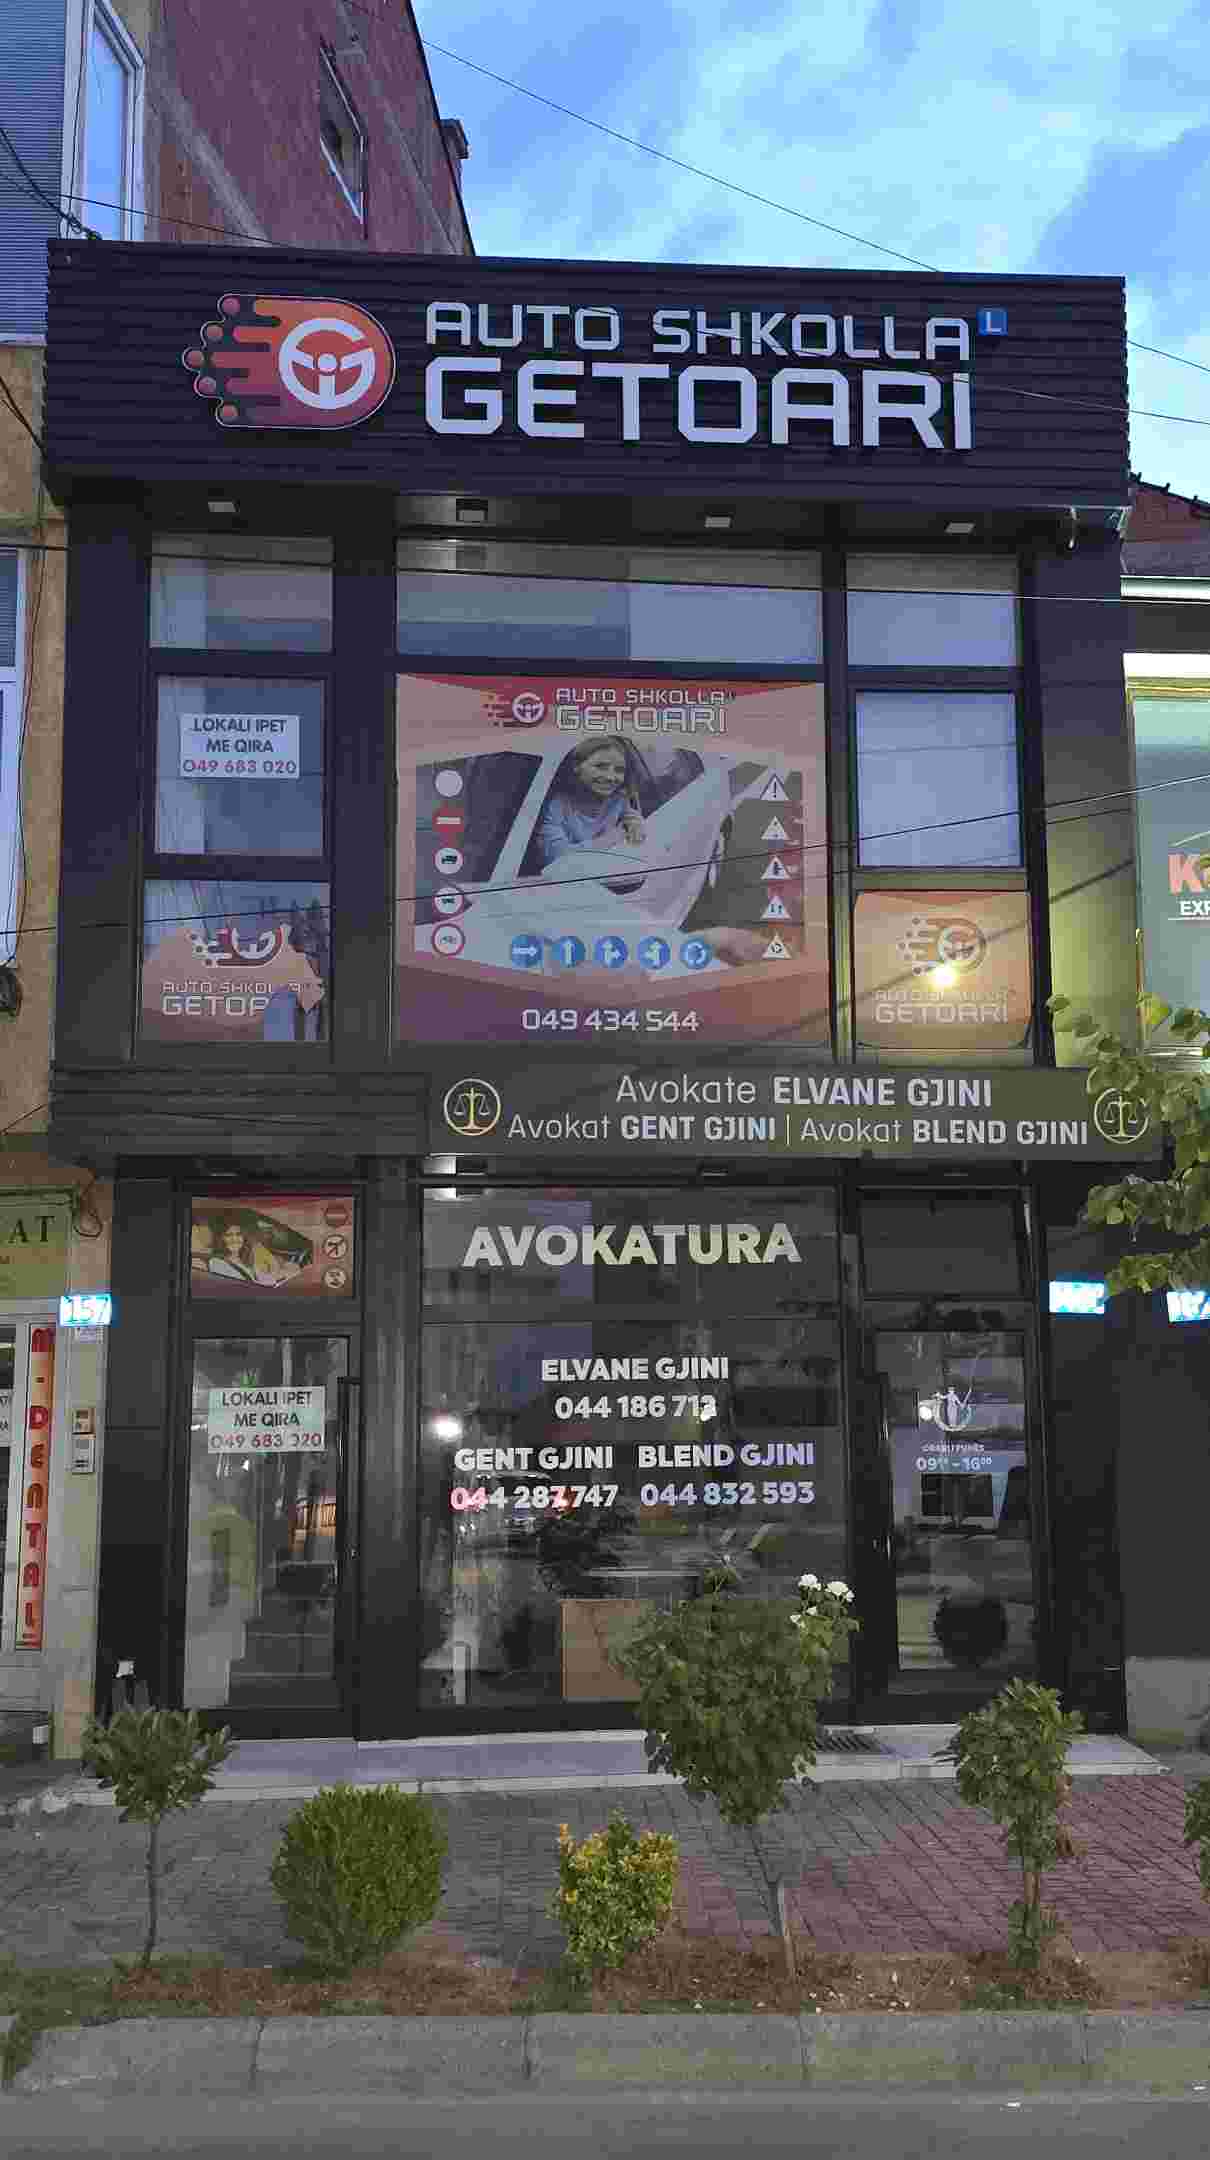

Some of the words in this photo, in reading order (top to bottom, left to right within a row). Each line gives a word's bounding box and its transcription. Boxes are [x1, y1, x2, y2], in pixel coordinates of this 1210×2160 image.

[425, 301, 620, 350] AUTO
[652, 310, 970, 361] SHKOLLA
[986, 311, 1001, 333] L
[425, 356, 972, 449] GETOARI
[556, 687, 617, 703] AUTO
[625, 689, 725, 704] SHKOLLA
[193, 718, 250, 733] LOKALI
[556, 704, 728, 733] GETOARI
[206, 739, 231, 753] ME
[234, 739, 274, 755] QIRA
[183, 759, 218, 773] 049
[1168, 854, 1210, 893] K
[521, 1008, 578, 1031] 049
[583, 1008, 640, 1032] 434
[645, 1009, 700, 1032] 544
[616, 1074, 757, 1104] Avokate
[773, 1076, 896, 1106] ELVANE
[907, 1078, 993, 1107] GJINI
[508, 1113, 611, 1140] Avokat
[620, 1115, 696, 1141] GENT
[704, 1116, 777, 1142] GJINI
[800, 1116, 903, 1144] Avokat
[913, 1119, 1007, 1144] BLEND
[1016, 1120, 1089, 1146] GJINI
[462, 1223, 803, 1267] AVOKATURA
[541, 1357, 650, 1382] ELVANE
[655, 1356, 730, 1381] GJINI
[222, 1391, 278, 1407] LOKALI
[555, 1395, 612, 1420] 044
[617, 1394, 667, 1419] 186
[233, 1412, 257, 1427] ME
[261, 1412, 301, 1427] QIRA
[454, 1447, 534, 1472] GENT
[538, 1445, 614, 1470] GJINI
[638, 1445, 735, 1469] BLEND
[740, 1442, 815, 1467] GJINI
[450, 1486, 508, 1511] 044
[513, 1484, 567, 1509] 287
[570, 1484, 619, 1508] 747
[640, 1483, 698, 1507] 044
[703, 1482, 758, 1505] 832
[762, 1481, 816, 1505] 593
